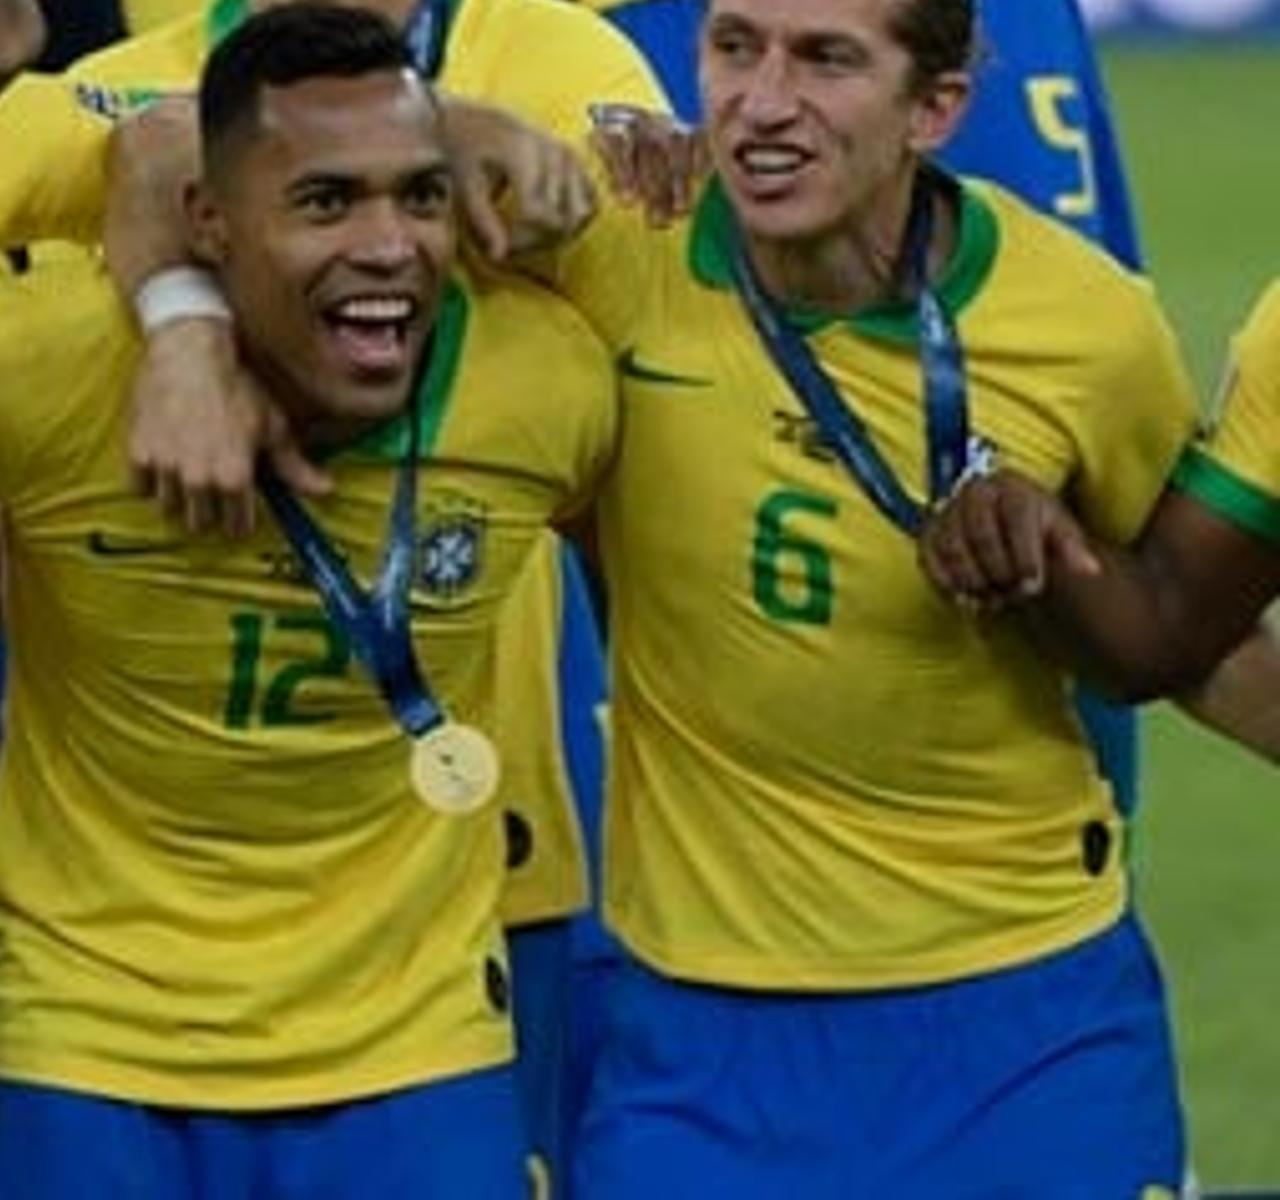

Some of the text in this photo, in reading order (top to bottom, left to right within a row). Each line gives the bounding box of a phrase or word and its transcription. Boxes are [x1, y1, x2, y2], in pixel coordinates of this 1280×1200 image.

[1025, 76, 1096, 215] 5
[753, 490, 837, 626] 6
[224, 612, 351, 728] 12
